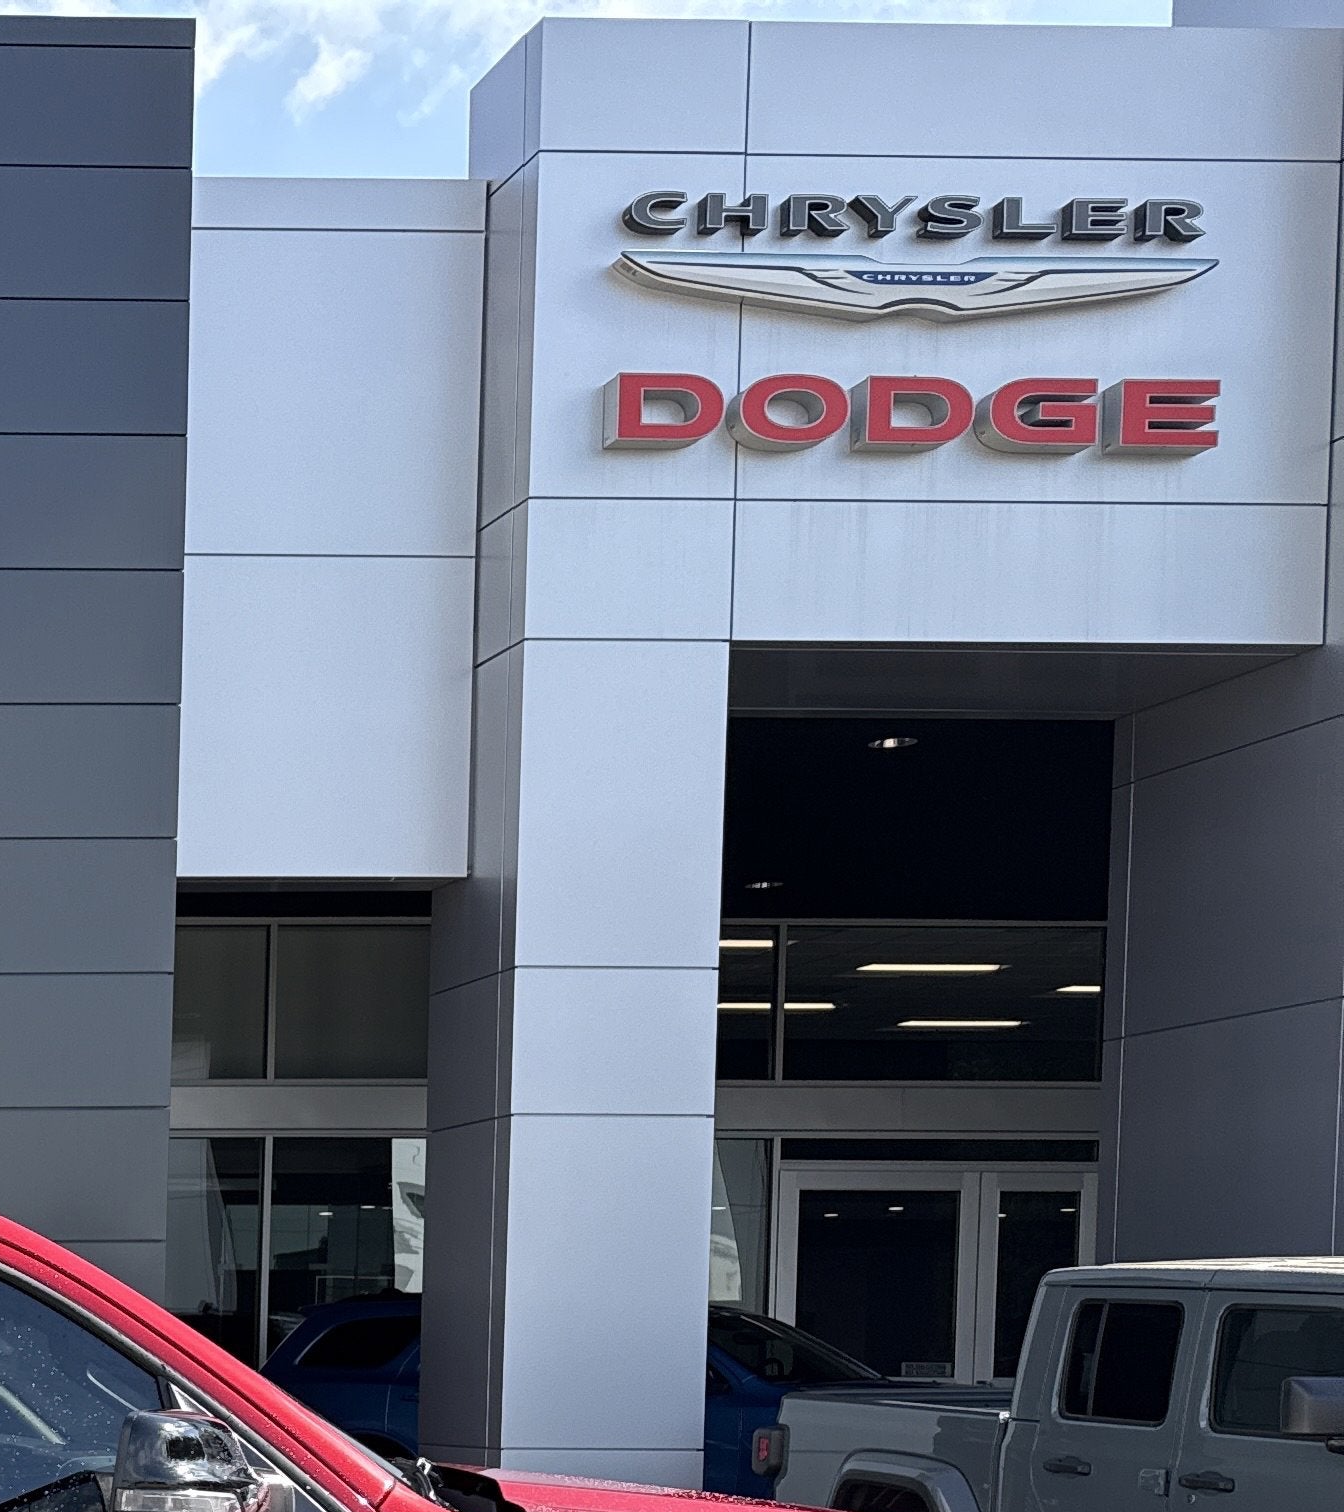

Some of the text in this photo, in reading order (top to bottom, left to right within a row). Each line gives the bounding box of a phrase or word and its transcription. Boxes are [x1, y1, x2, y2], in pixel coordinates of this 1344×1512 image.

[622, 190, 1205, 243] CHRYSLER
[862, 273, 976, 282] CHRYSLER
[602, 372, 1221, 456] DODGE
